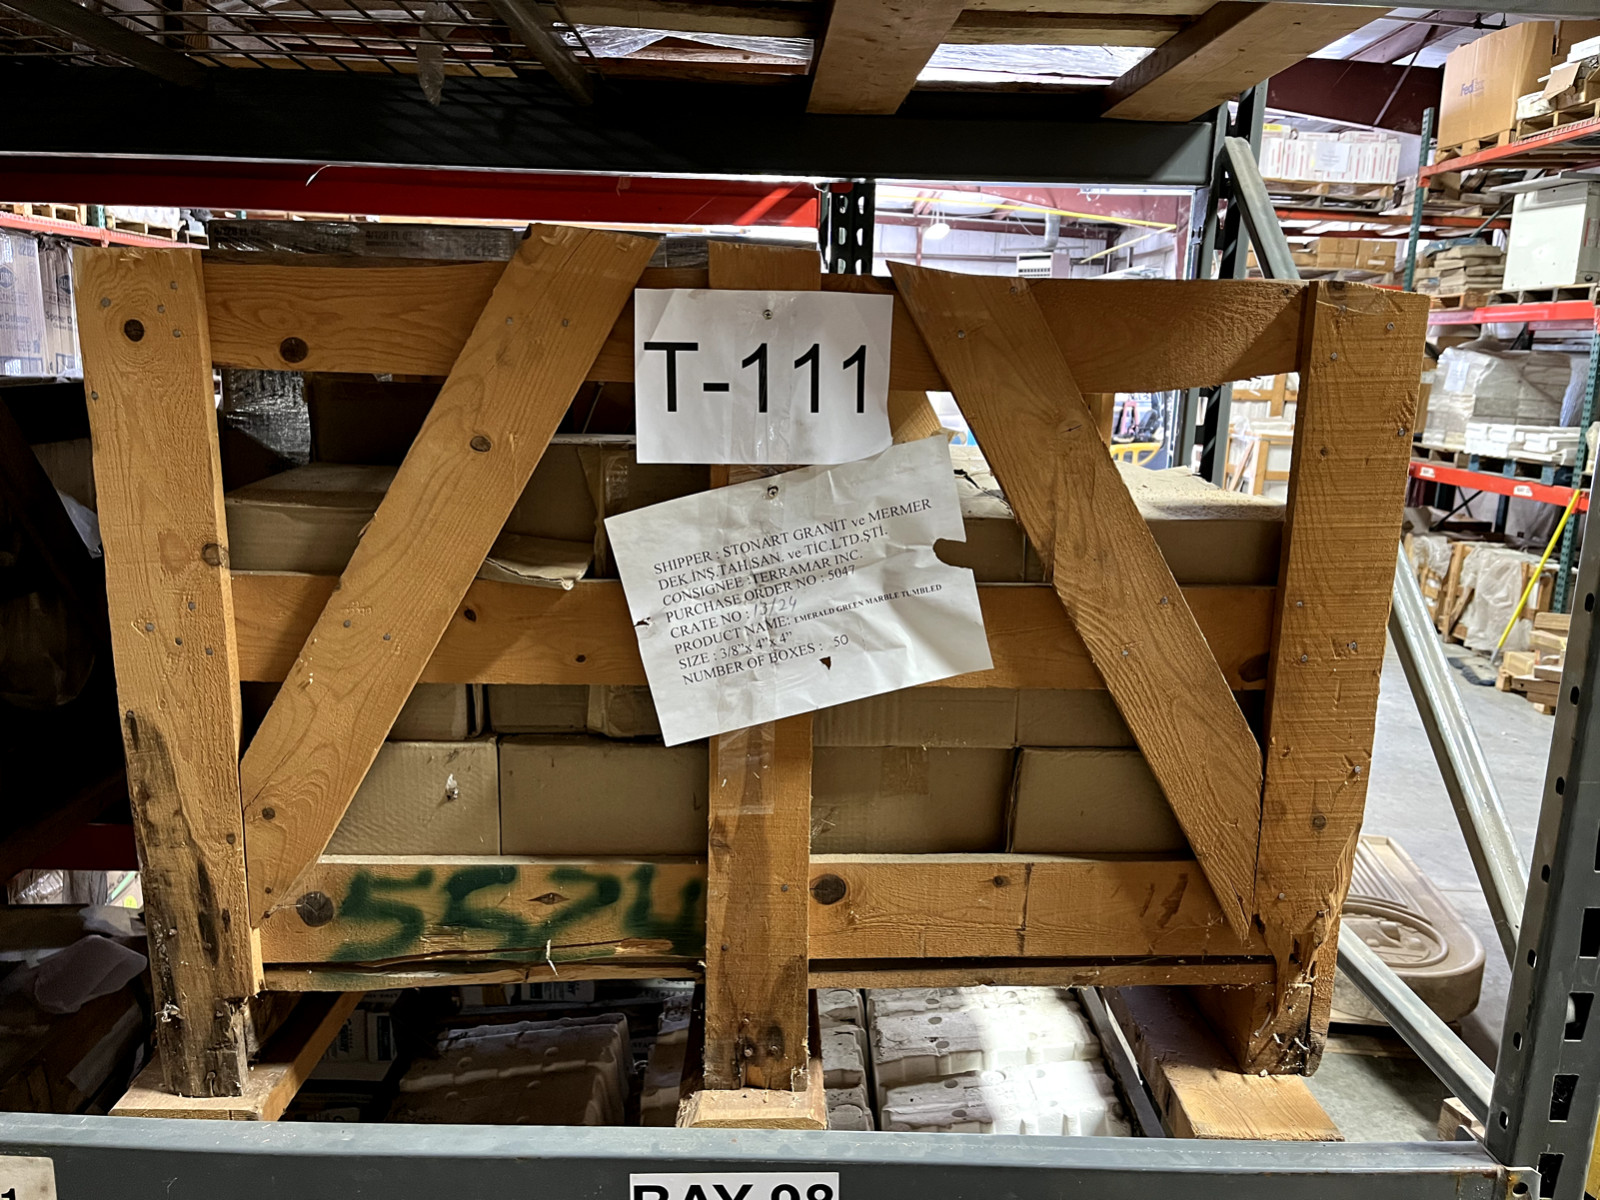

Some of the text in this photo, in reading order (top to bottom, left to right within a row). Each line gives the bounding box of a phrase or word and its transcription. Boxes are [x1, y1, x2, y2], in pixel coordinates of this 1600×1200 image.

[644, 342, 866, 413] T-111
[653, 550, 713, 575] SHIPPER
[722, 532, 789, 558] STONART
[851, 516, 866, 528] ve
[867, 498, 932, 522] MERMER
[787, 548, 801, 560] ve
[662, 576, 744, 606] CONSIGNEE
[834, 549, 864, 565] INC.
[665, 593, 741, 623] PURCHASE
[744, 580, 793, 602] ORDER
[796, 574, 817, 589] NO
[827, 564, 856, 581] 5047
[670, 616, 718, 639] CRATE
[720, 610, 742, 626] NO
[674, 627, 740, 655] PRODUCT
[794, 607, 835, 624] EMERALD
[836, 600, 864, 613] GREEN
[865, 591, 900, 605] MARBLE
[901, 584, 942, 598] TUMBLED
[678, 653, 711, 670] SIZE
[682, 660, 744, 686] NUMBER
[746, 656, 765, 670] OF
[768, 642, 815, 665] BOXES
[833, 633, 849, 648] 50
